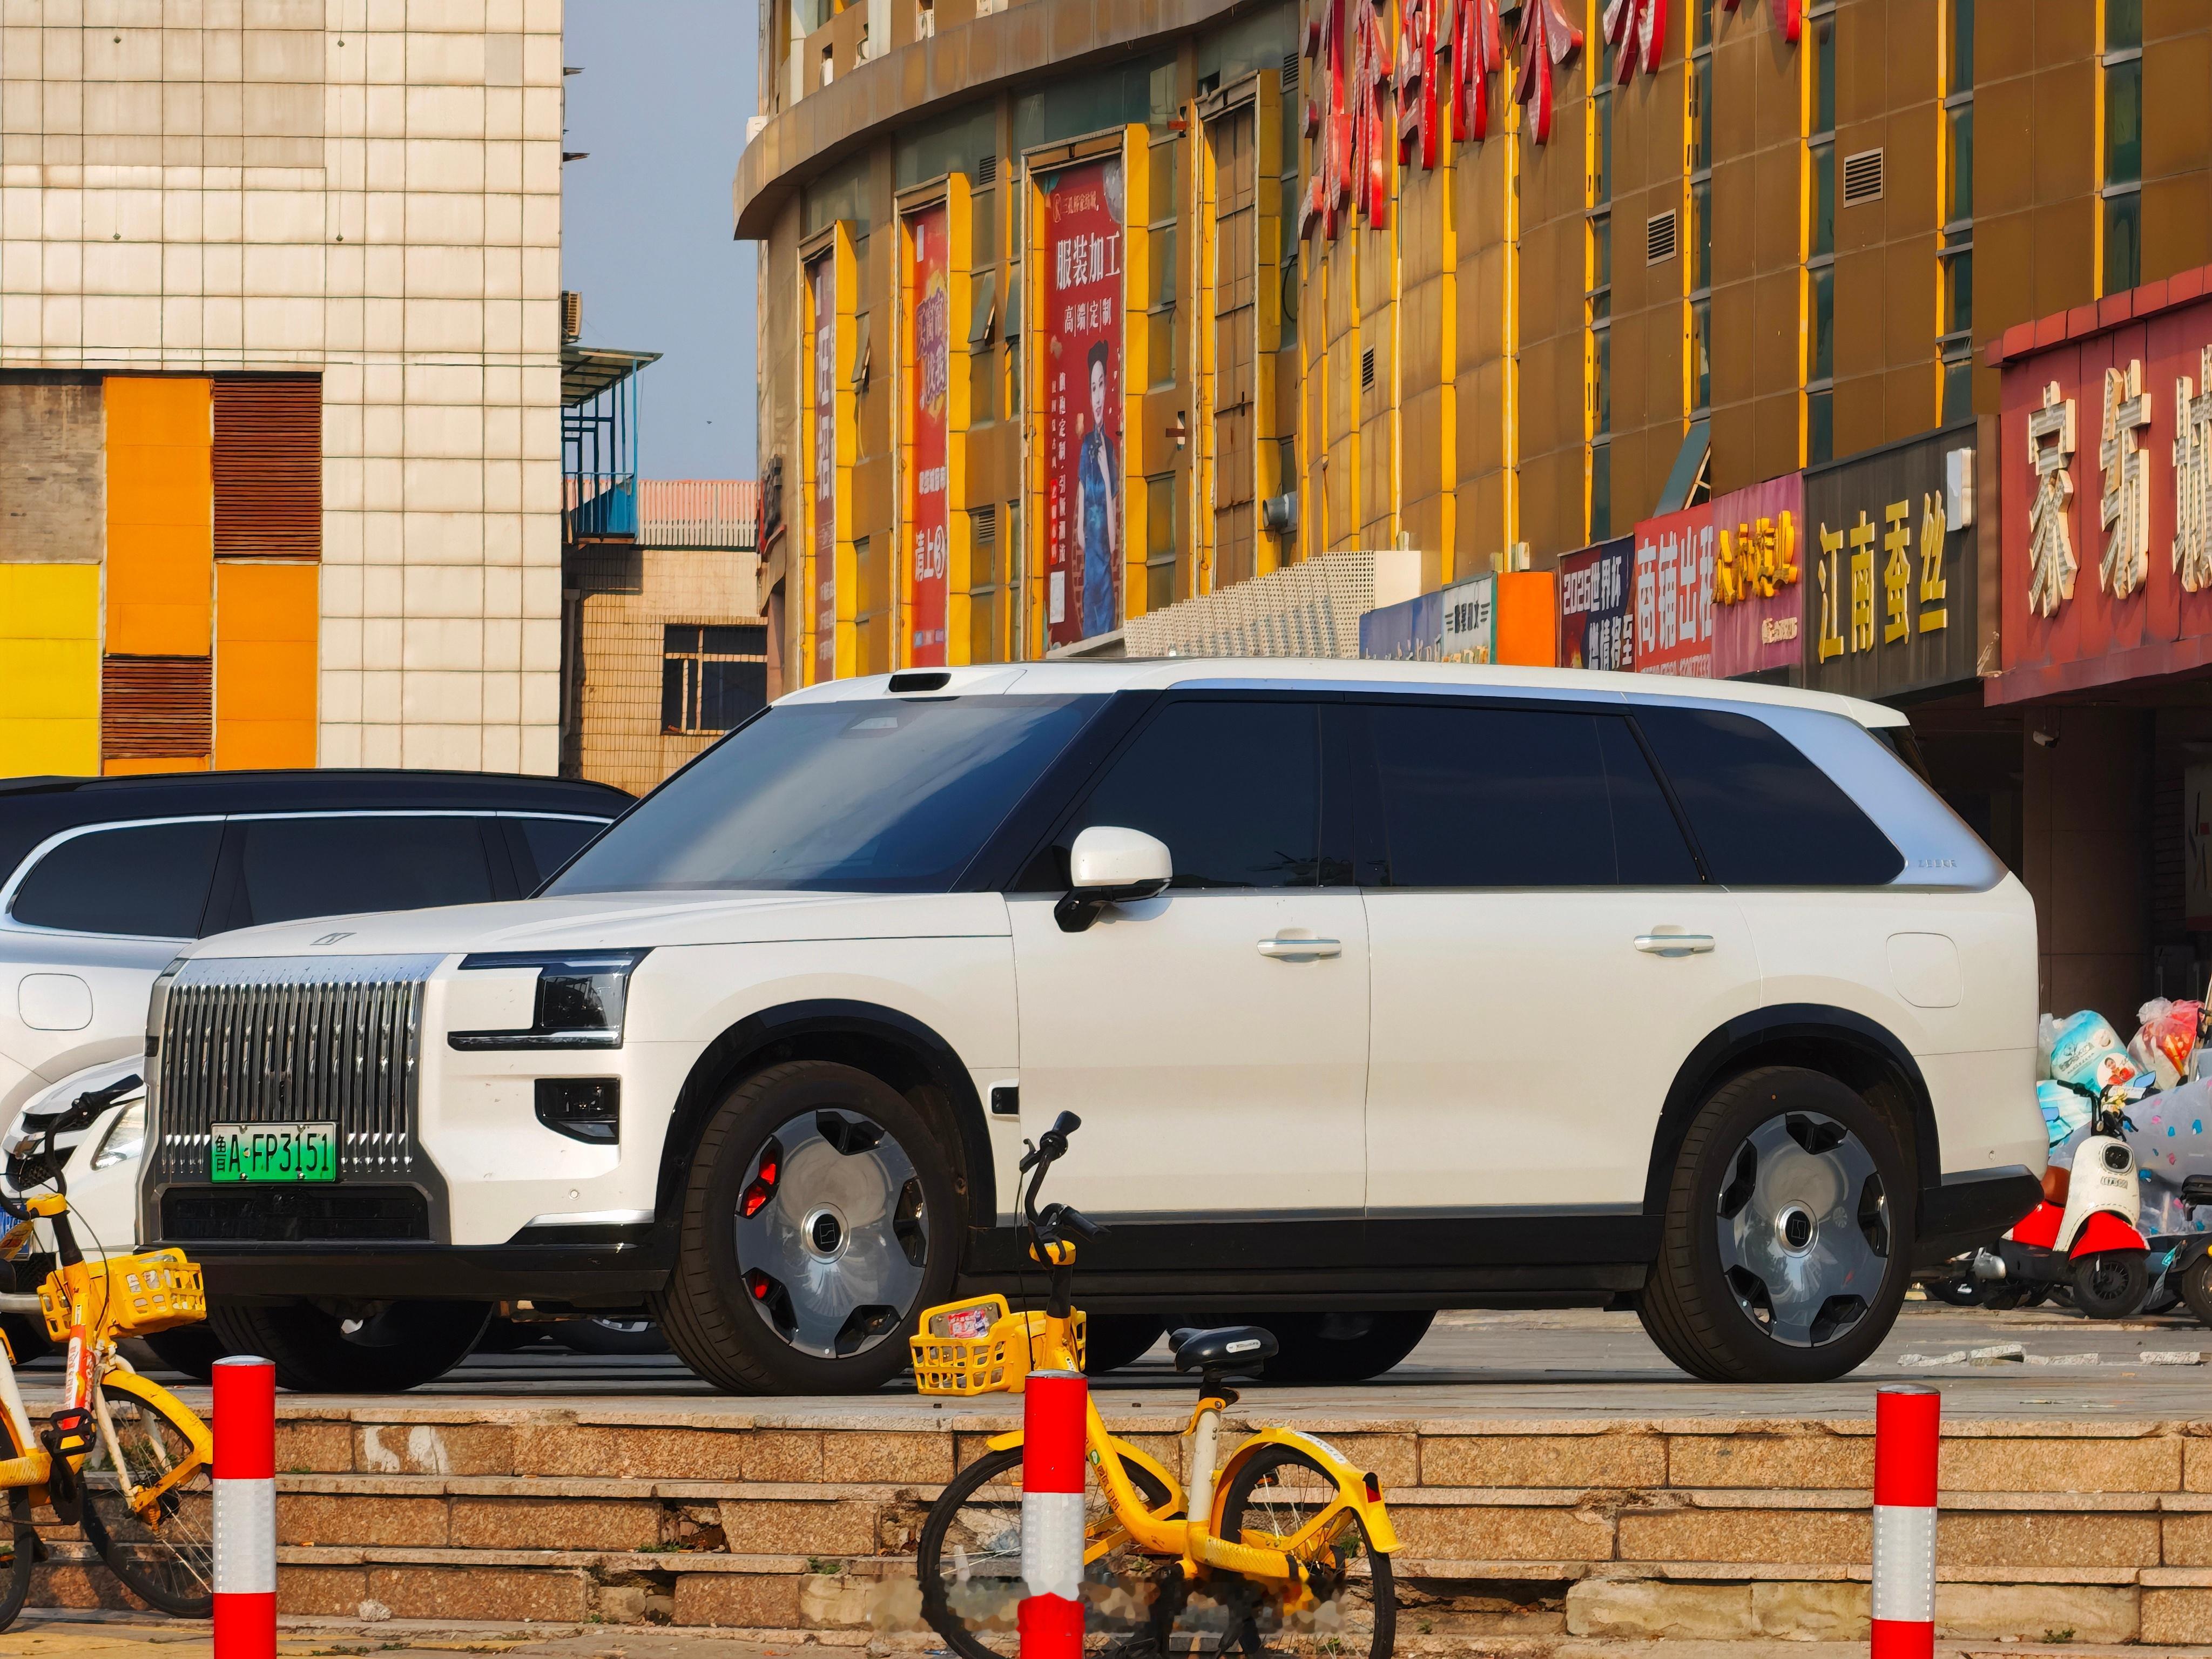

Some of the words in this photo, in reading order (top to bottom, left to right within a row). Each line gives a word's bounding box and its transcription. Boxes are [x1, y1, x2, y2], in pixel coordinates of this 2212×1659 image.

[1056, 231, 1121, 291] 服装加工
[1563, 555, 1622, 615] 2026世界杯
[1637, 524, 1714, 657] 商铺出租
[1817, 489, 1949, 664] 江南蚕丝
